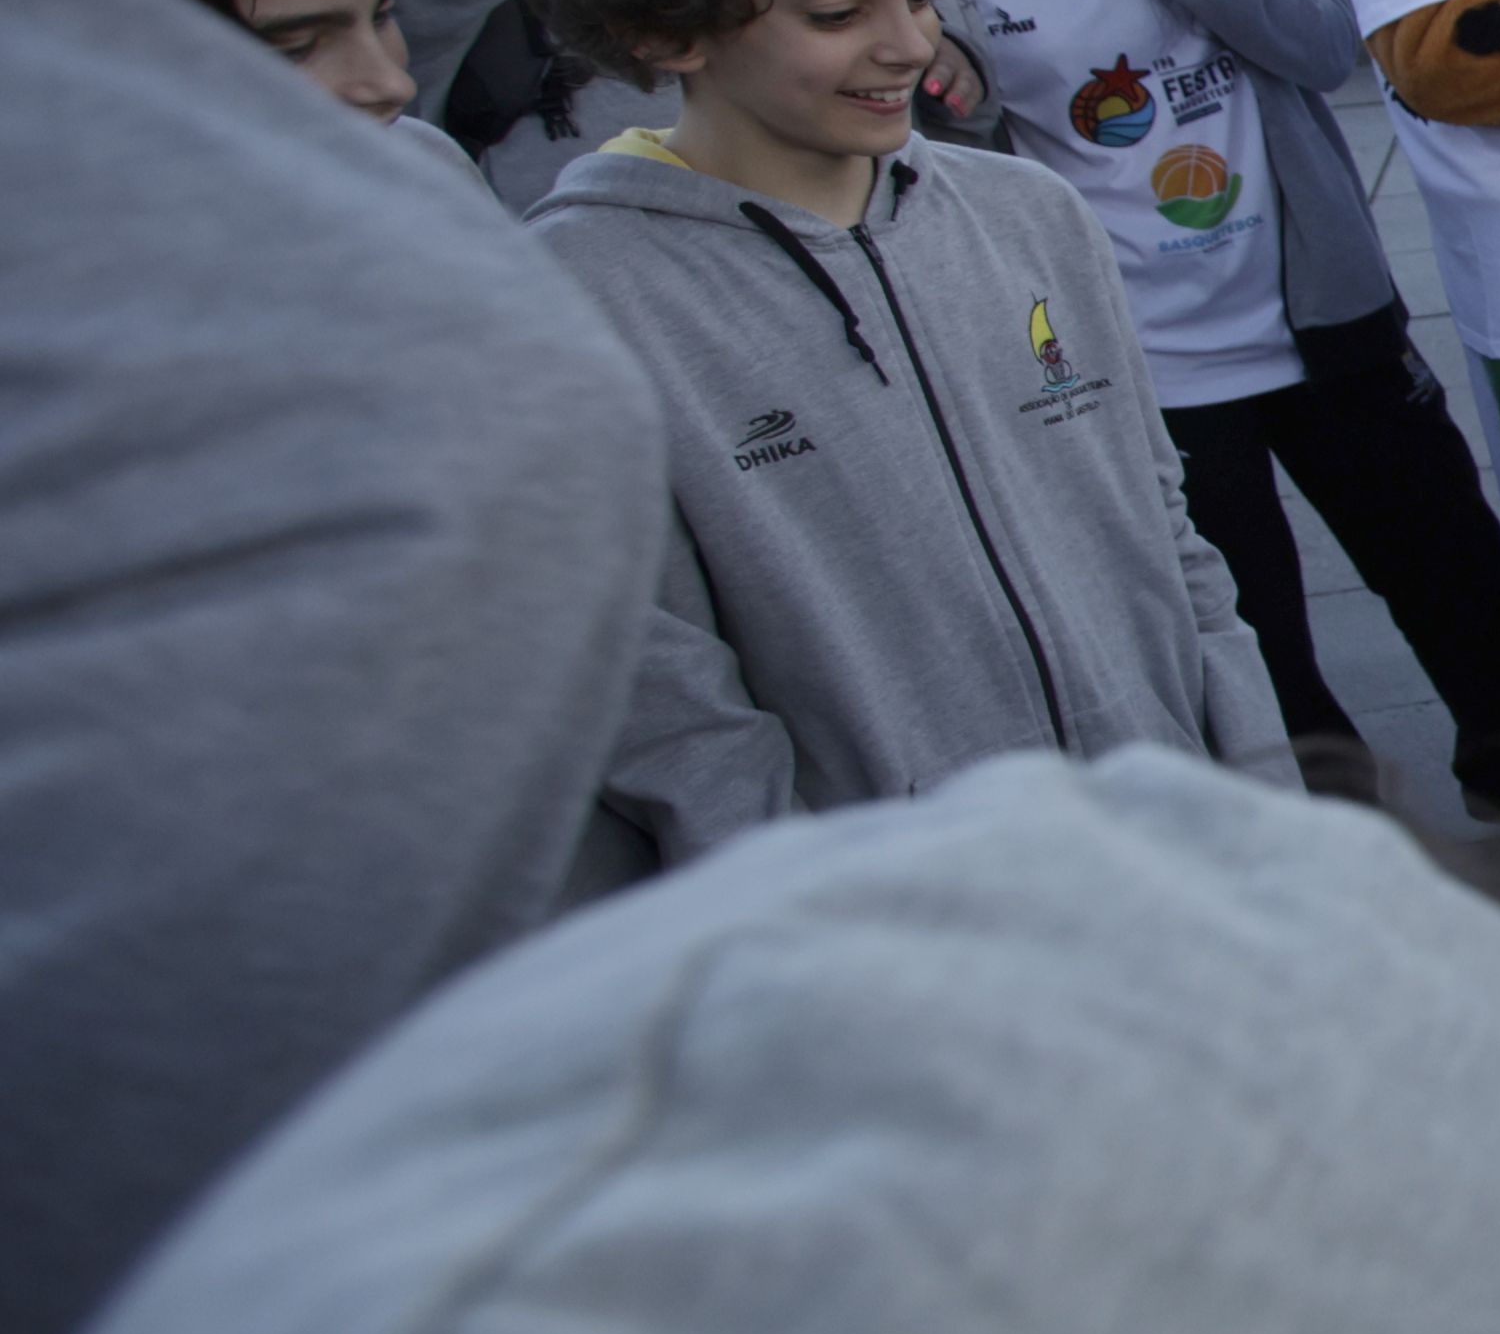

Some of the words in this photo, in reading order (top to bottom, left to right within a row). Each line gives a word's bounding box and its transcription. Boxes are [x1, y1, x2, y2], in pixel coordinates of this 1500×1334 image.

[1162, 54, 1236, 103] FESTA
[1158, 213, 1265, 254] BASQUETEBOL
[734, 436, 818, 473] DHIKA
